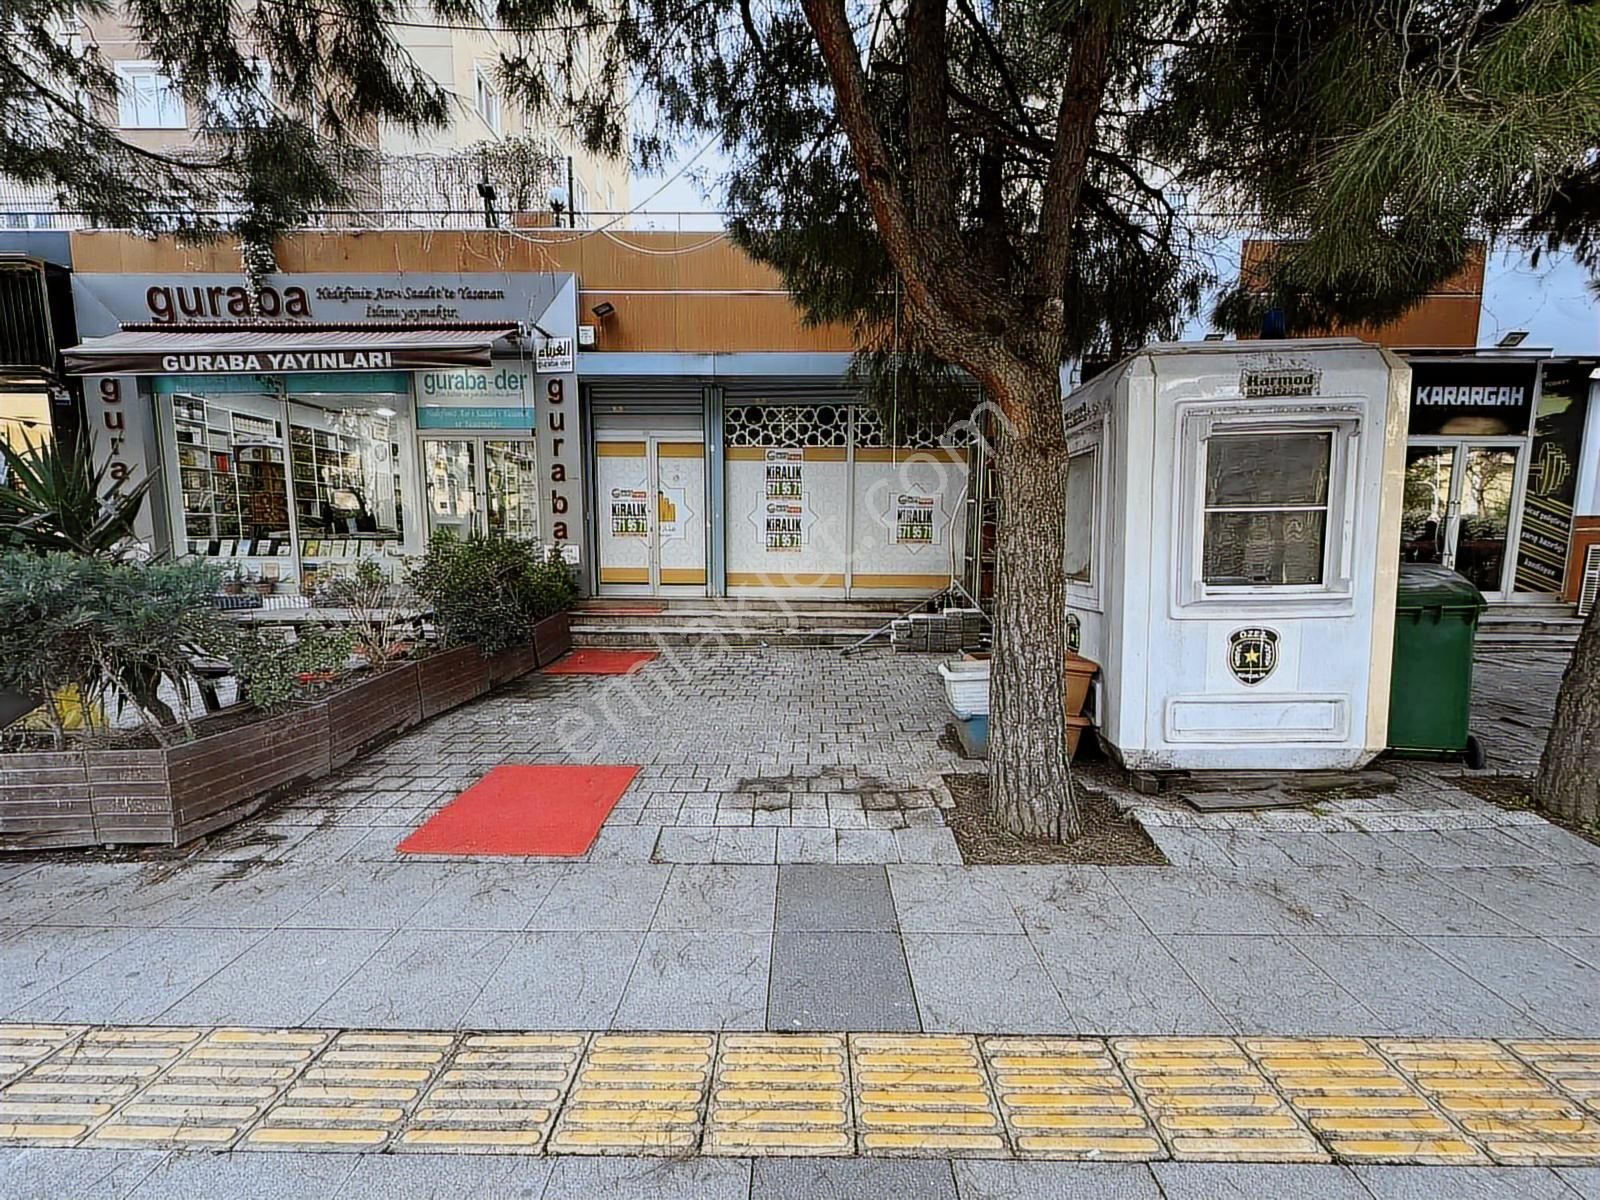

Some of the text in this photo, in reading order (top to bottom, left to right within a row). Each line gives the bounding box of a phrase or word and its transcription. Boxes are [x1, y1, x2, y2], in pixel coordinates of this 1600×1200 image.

[162, 352, 392, 371] GURABA YAYINLARI
[424, 368, 527, 395] guraba-der
[1416, 386, 1525, 406] KARARGAH
[100, 378, 130, 480] gura
[547, 378, 570, 540] guraba
